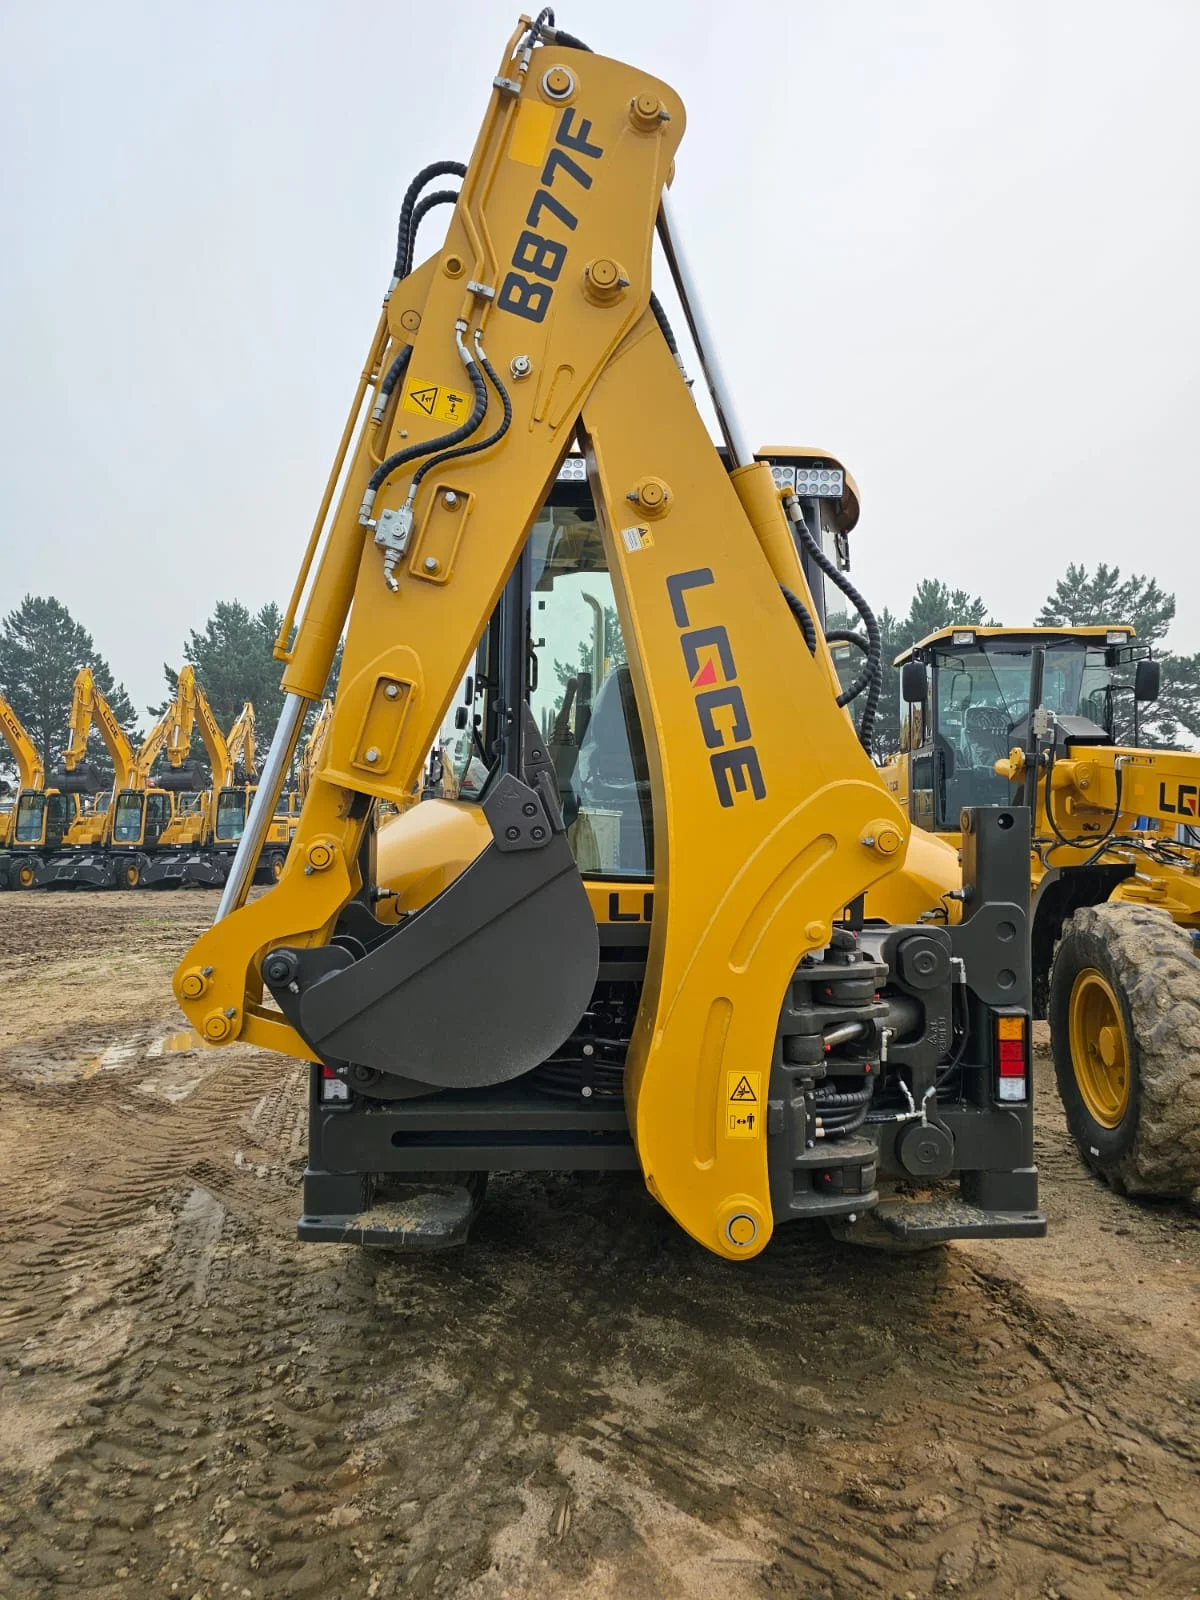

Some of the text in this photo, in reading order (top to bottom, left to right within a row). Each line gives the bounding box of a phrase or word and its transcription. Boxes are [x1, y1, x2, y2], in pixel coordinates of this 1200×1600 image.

[497, 108, 604, 323] B877F
[666, 567, 766, 808] LGCE
[1160, 782, 1200, 817] LG
